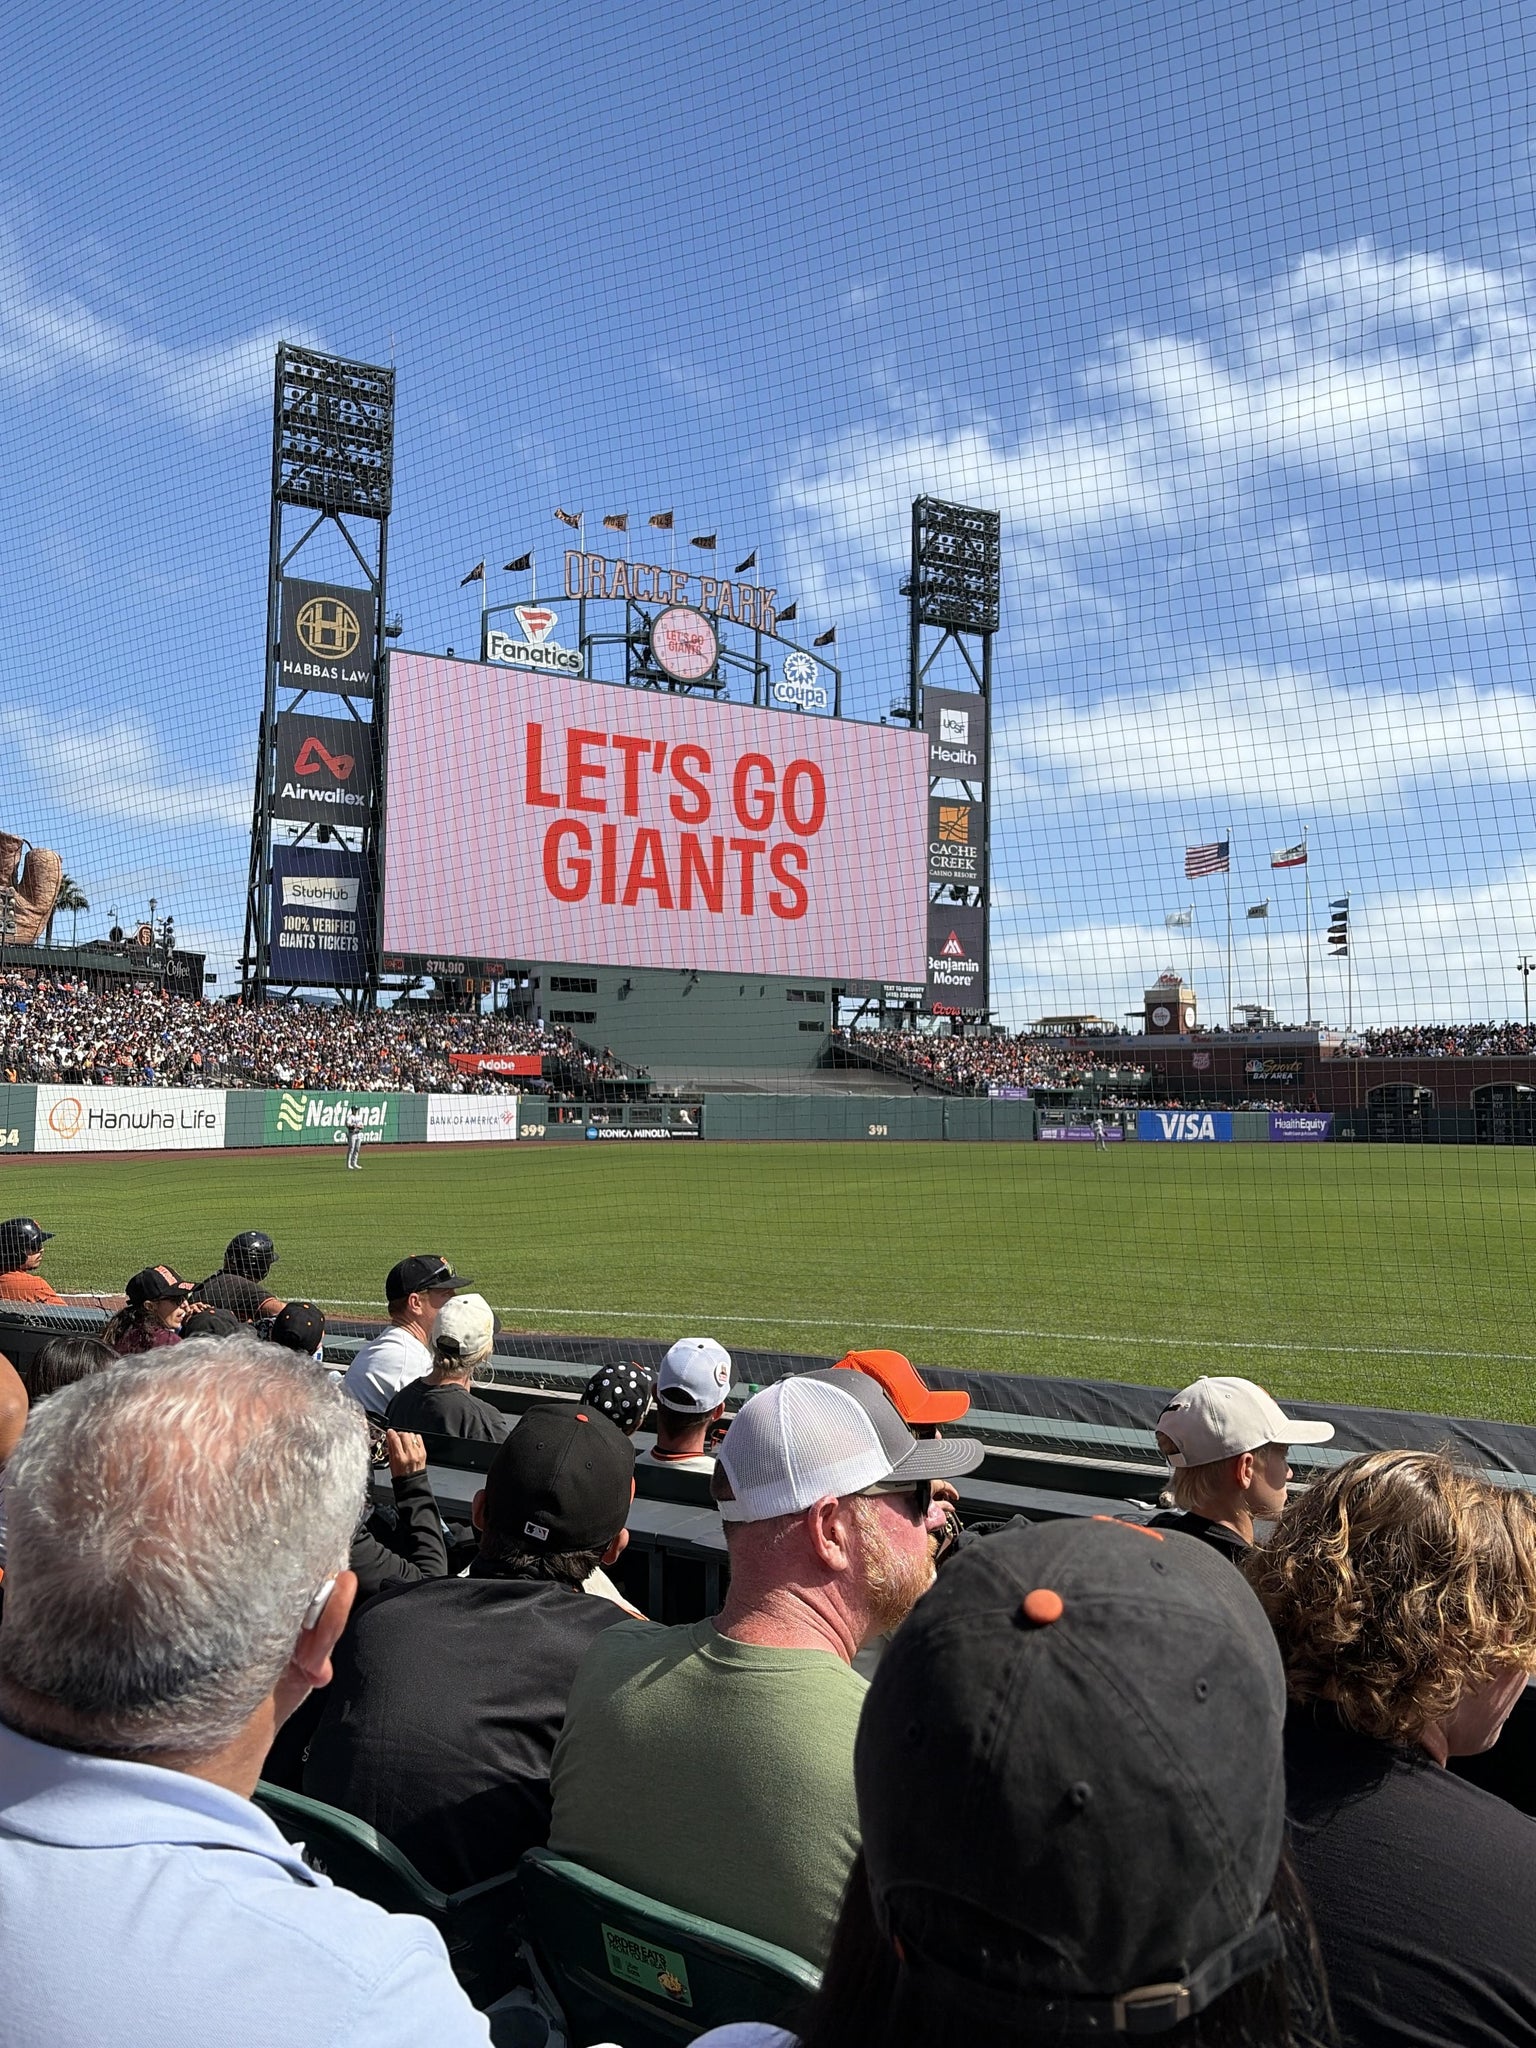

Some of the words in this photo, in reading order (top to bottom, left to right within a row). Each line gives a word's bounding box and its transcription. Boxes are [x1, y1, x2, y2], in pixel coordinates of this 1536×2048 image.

[563, 550, 689, 606] ORACLE
[699, 575, 778, 636] PARK
[666, 630, 689, 642] LET'S
[691, 634, 704, 646] GO
[492, 635, 579, 668] Fanatics
[668, 641, 702, 655] GIANTS
[283, 660, 338, 679] HABBAS
[341, 668, 370, 683] LAW
[777, 684, 824, 706] coupa
[943, 719, 965, 734] UCSF
[931, 745, 977, 765] Health
[525, 722, 711, 824] LET'S
[733, 752, 826, 837] GO
[281, 782, 365, 806] Airwallex
[929, 843, 978, 858] CACHE
[543, 818, 809, 920] GIANTS
[931, 856, 976, 870] CREEK
[929, 869, 952, 877] CASINO
[953, 871, 977, 879] RESORT
[292, 885, 349, 900] StubHub
[283, 916, 310, 932] 100%
[312, 918, 356, 935] VERIFIED
[280, 933, 316, 950] GIANTS
[318, 935, 359, 951] TICKETS
[166, 960, 190, 978] Coffee
[426, 960, 465, 975] $74,910
[928, 956, 979, 973] Benjamin
[934, 971, 971, 986] Moore
[933, 1001, 960, 1015] Coors
[961, 1007, 985, 1016] LIGHT
[477, 1059, 515, 1070] Adobe
[1263, 1059, 1302, 1072] Sports
[88, 1108, 174, 1129] Hanwha
[181, 1109, 216, 1129] Life
[430, 1116, 453, 1125] BANK
[453, 1116, 463, 1125] OF
[465, 1115, 498, 1125] AMERICA
[1275, 1118, 1326, 1131] HealthEquity
[520, 1125, 546, 1137] 399
[599, 1129, 632, 1138] KONICA
[633, 1129, 671, 1138] MINOLTA
[868, 1124, 888, 1136] 391
[1156, 1114, 1215, 1140] VISA
[1341, 1128, 1355, 1137] 415
[333, 1130, 348, 1143] Ca
[360, 1129, 382, 1142] ental
[607, 1932, 640, 1955] ORDER
[641, 1946, 666, 1964] EATS
